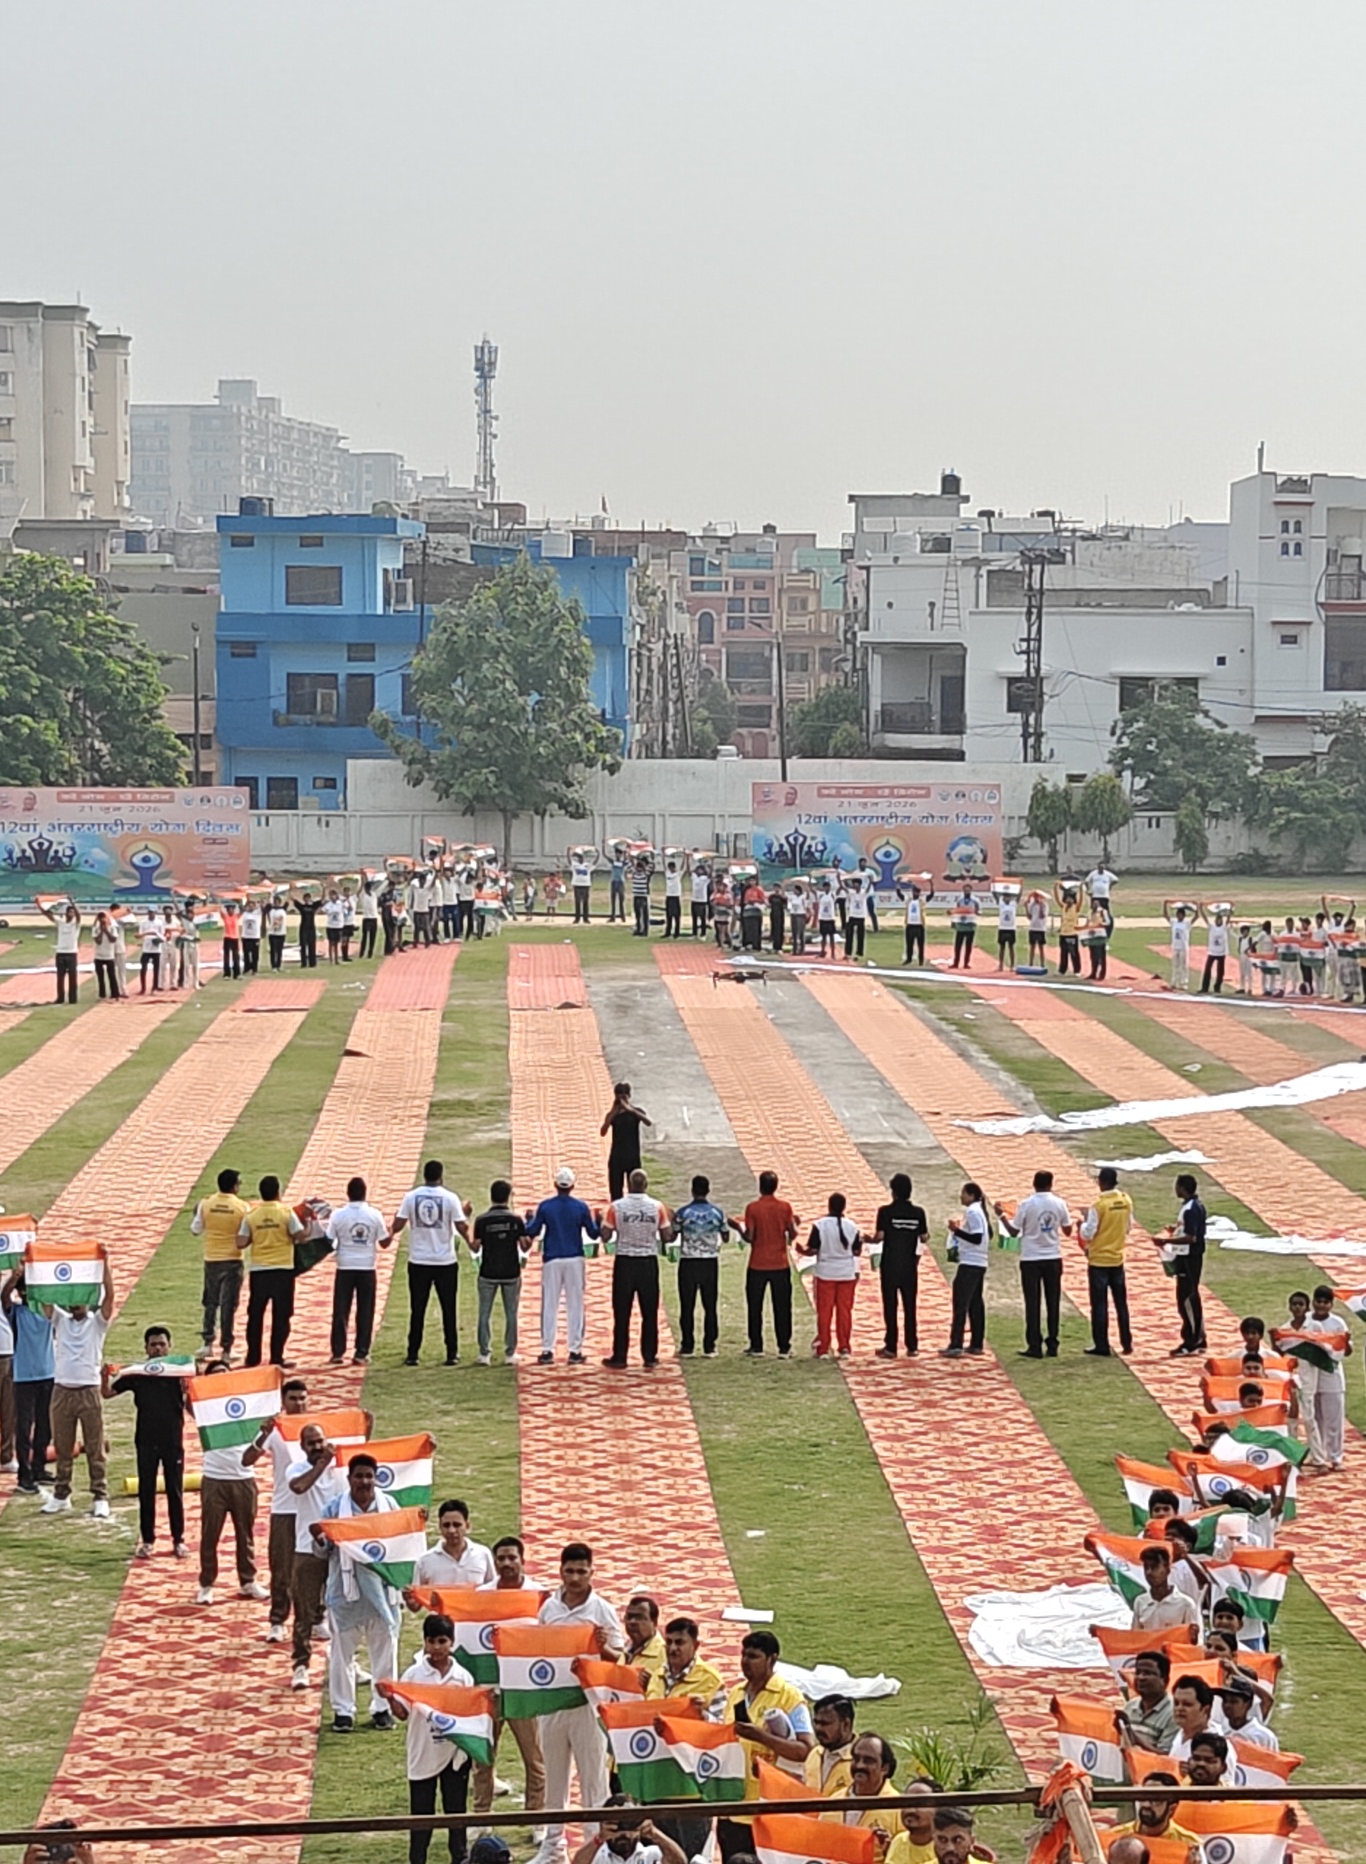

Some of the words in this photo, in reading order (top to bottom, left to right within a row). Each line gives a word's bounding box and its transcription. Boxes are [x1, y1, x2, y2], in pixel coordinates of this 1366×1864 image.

[78, 805, 93, 813] 21
[128, 805, 161, 813] 2026
[917, 812, 950, 824] योग
[955, 812, 993, 825] दिवस
[149, 818, 188, 832] योग
[195, 819, 241, 833] दिवस
